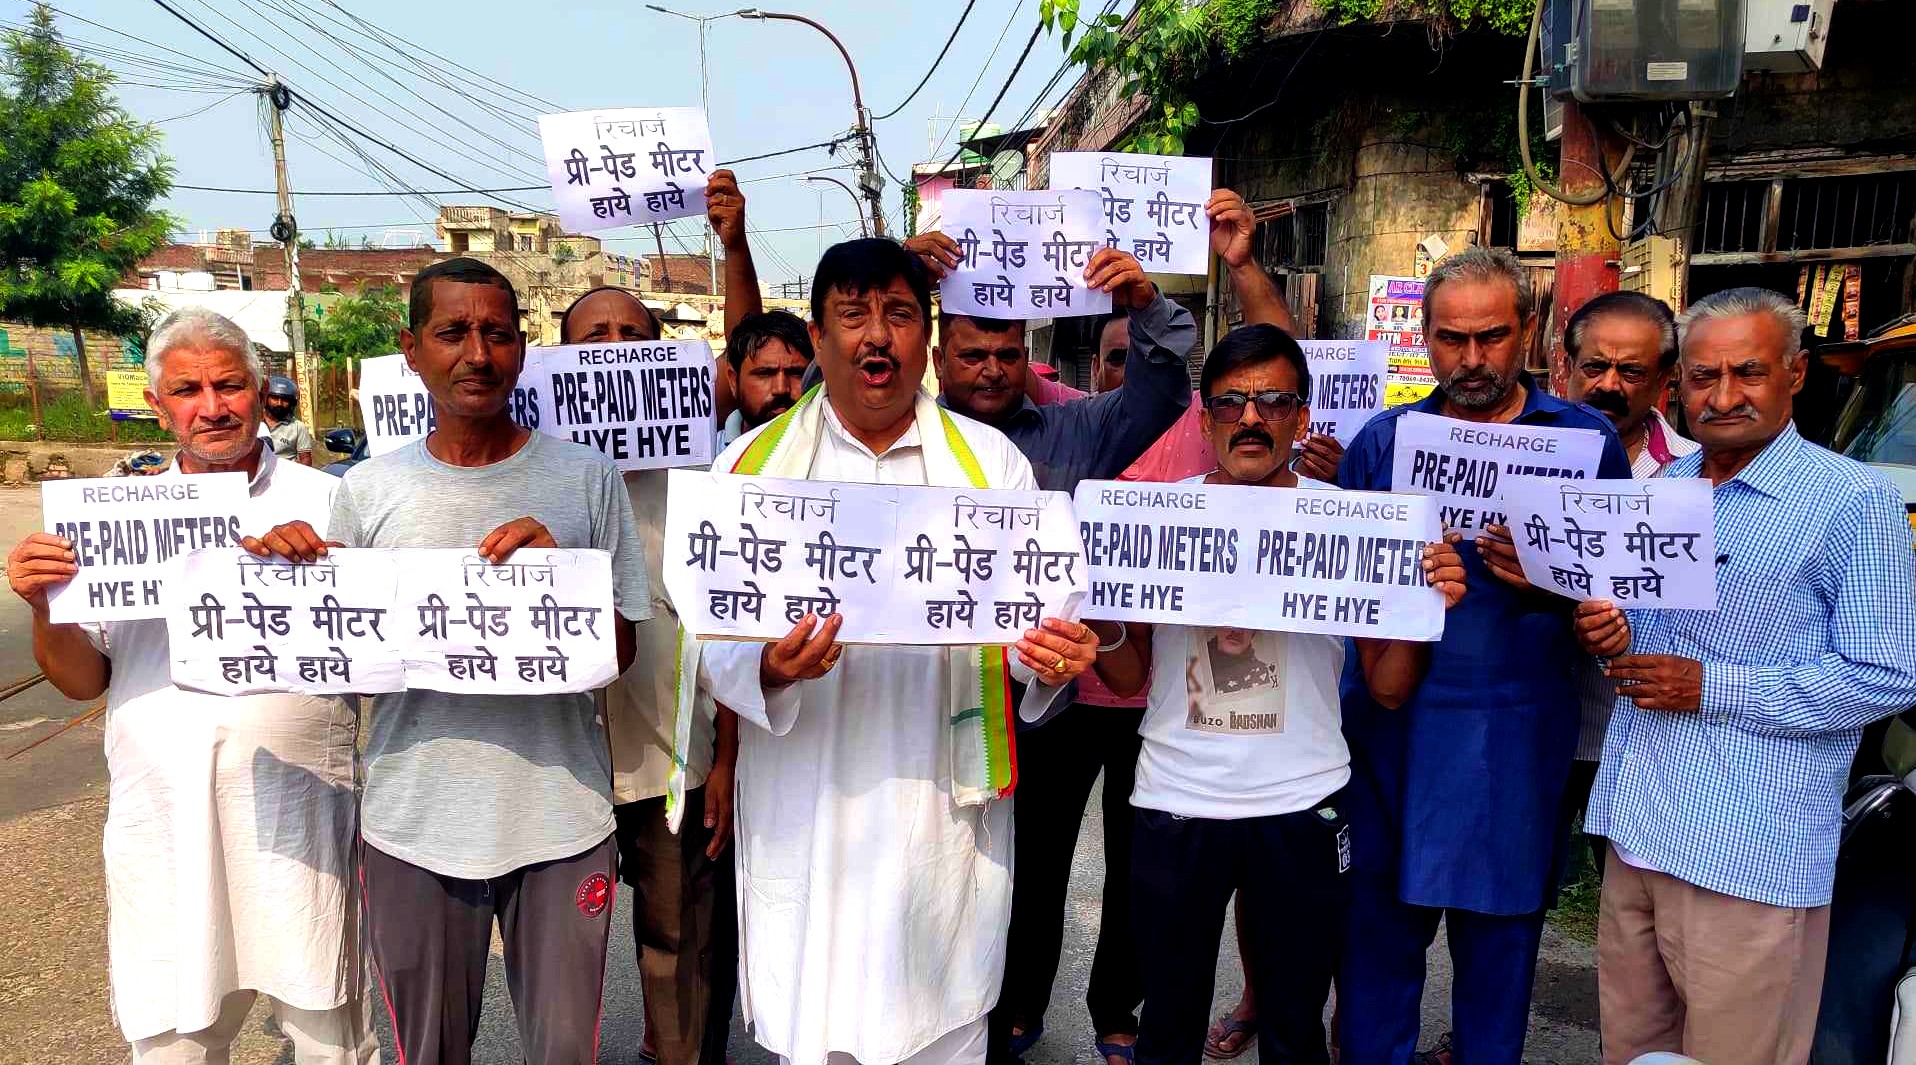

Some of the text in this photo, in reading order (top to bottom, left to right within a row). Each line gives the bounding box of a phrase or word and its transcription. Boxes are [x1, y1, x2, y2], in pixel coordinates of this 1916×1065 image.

[593, 112, 666, 140] रिचार्ज
[564, 142, 706, 186] प्री-पेड मीटर
[1100, 157, 1171, 186] रिचार्ज
[590, 181, 685, 219] हाये हाये
[990, 195, 1067, 225] रिचार्ज
[1147, 191, 1201, 229] मीटर
[1133, 232, 1173, 262] हाये
[972, 275, 1074, 308] हाये हाये
[579, 346, 678, 366] RECHARGE
[1304, 347, 1356, 361] HARGE
[551, 369, 637, 426] PRE-PAID
[640, 365, 712, 421] METERS
[1317, 373, 1379, 410] METERS
[373, 393, 436, 436] PRE-PA
[637, 424, 691, 459] HYE
[1449, 427, 1558, 454] RECHARGE
[1410, 449, 1499, 500] PRE-PAID
[83, 484, 200, 503] RECHARGE
[739, 482, 841, 524] रिचार्ज
[1100, 489, 1207, 509] RECHARGE
[1295, 497, 1409, 521] RECHARGE
[1559, 484, 1654, 515] रिचार्ज
[953, 494, 1046, 530] रिचार्ज
[686, 520, 882, 584] प्री-पेड मीटर
[1079, 521, 1239, 575] RE-PAID METERS
[1524, 513, 1701, 562] प्री-पेड मीटर
[236, 554, 339, 587] रिचार्ज
[461, 555, 558, 587] रिचार्ज
[904, 533, 1080, 586] प्री-पेड मीटर
[1256, 529, 1426, 587] PRE-PAID METER
[88, 581, 135, 608] HYE
[1091, 581, 1184, 611] HYE HYE
[1549, 563, 1664, 600] हाये हाये
[189, 592, 293, 640] प्री-पेड
[309, 594, 387, 642] मीटर
[417, 592, 602, 640] प्री-पेड मीटर
[708, 580, 766, 623] हाये
[926, 590, 1045, 629] हाये हाये
[1281, 592, 1381, 625] HYE HYE
[219, 645, 352, 684] हाये हाये
[445, 646, 569, 682] हाये हाये
